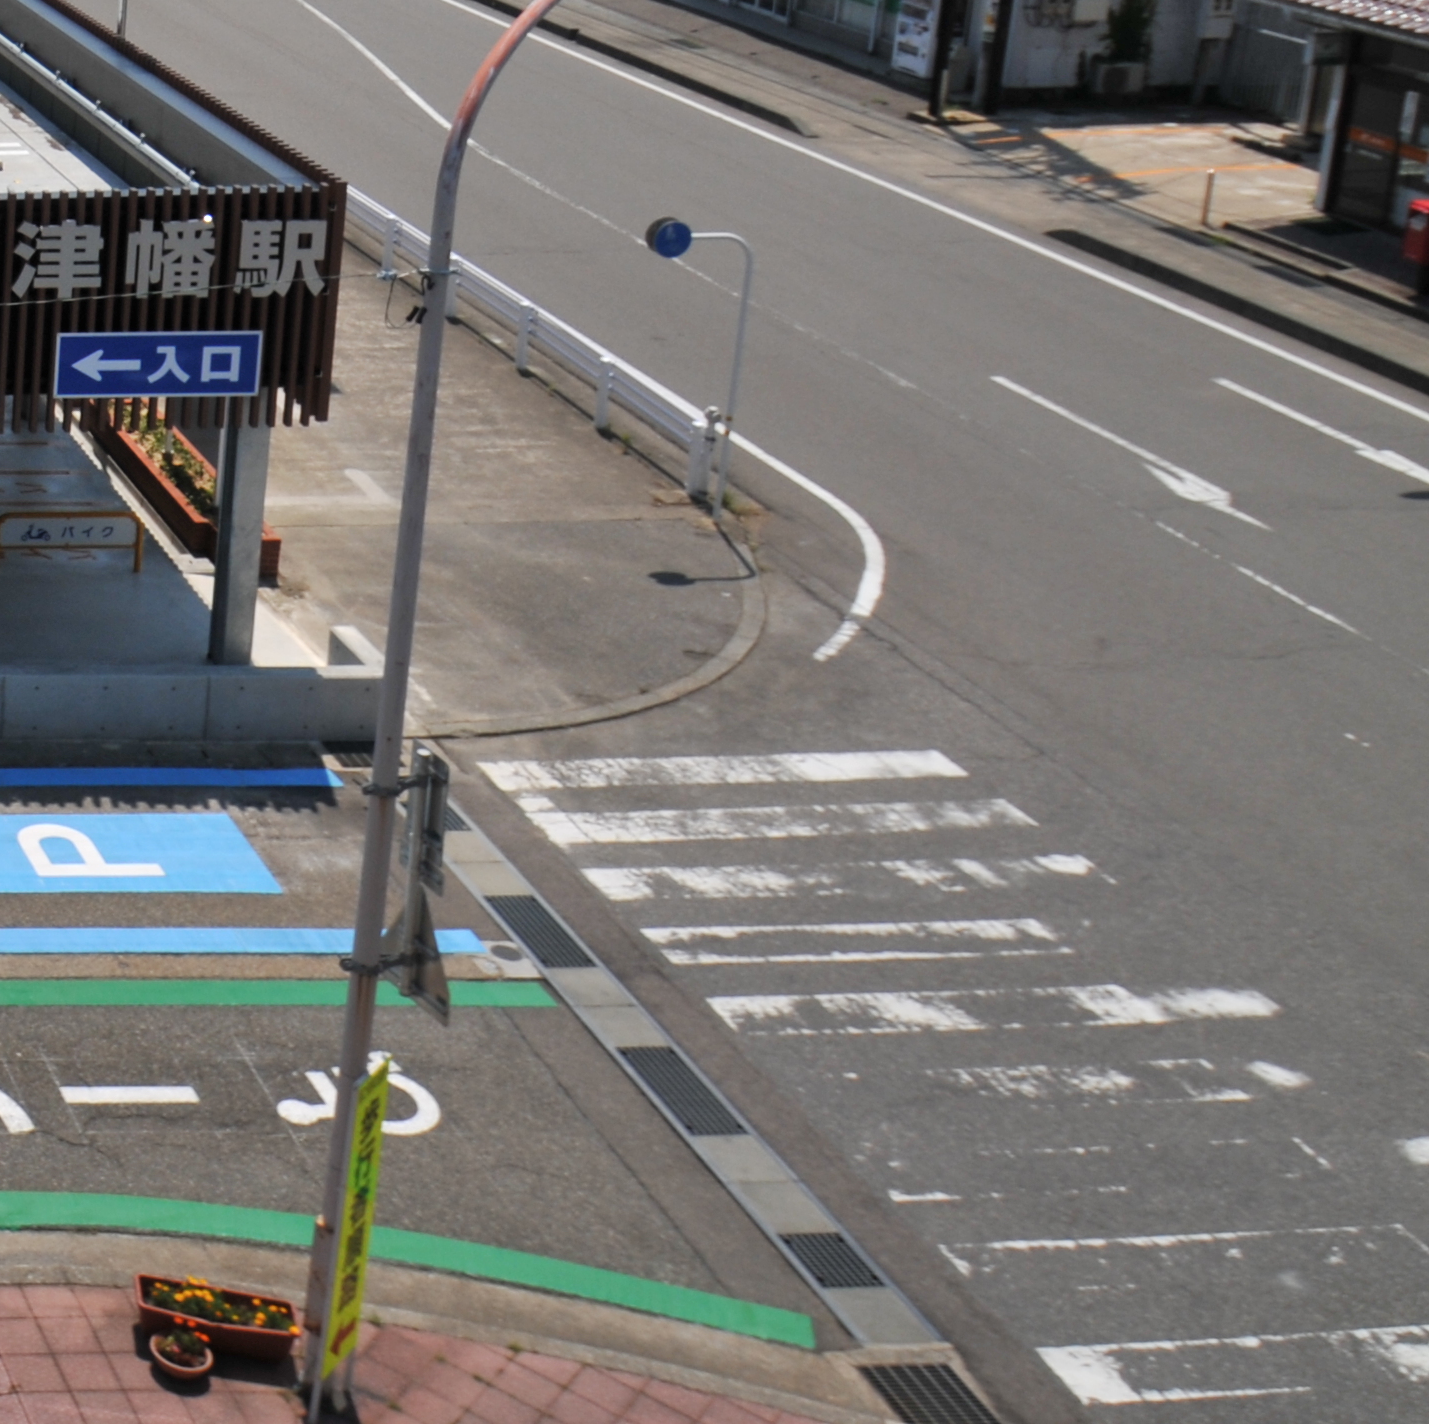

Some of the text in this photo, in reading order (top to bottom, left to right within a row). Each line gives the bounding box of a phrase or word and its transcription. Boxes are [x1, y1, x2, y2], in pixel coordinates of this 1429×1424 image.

[11, 214, 328, 300] 津幡駅
[147, 345, 242, 384] 入口
[60, 525, 114, 538] バイク
